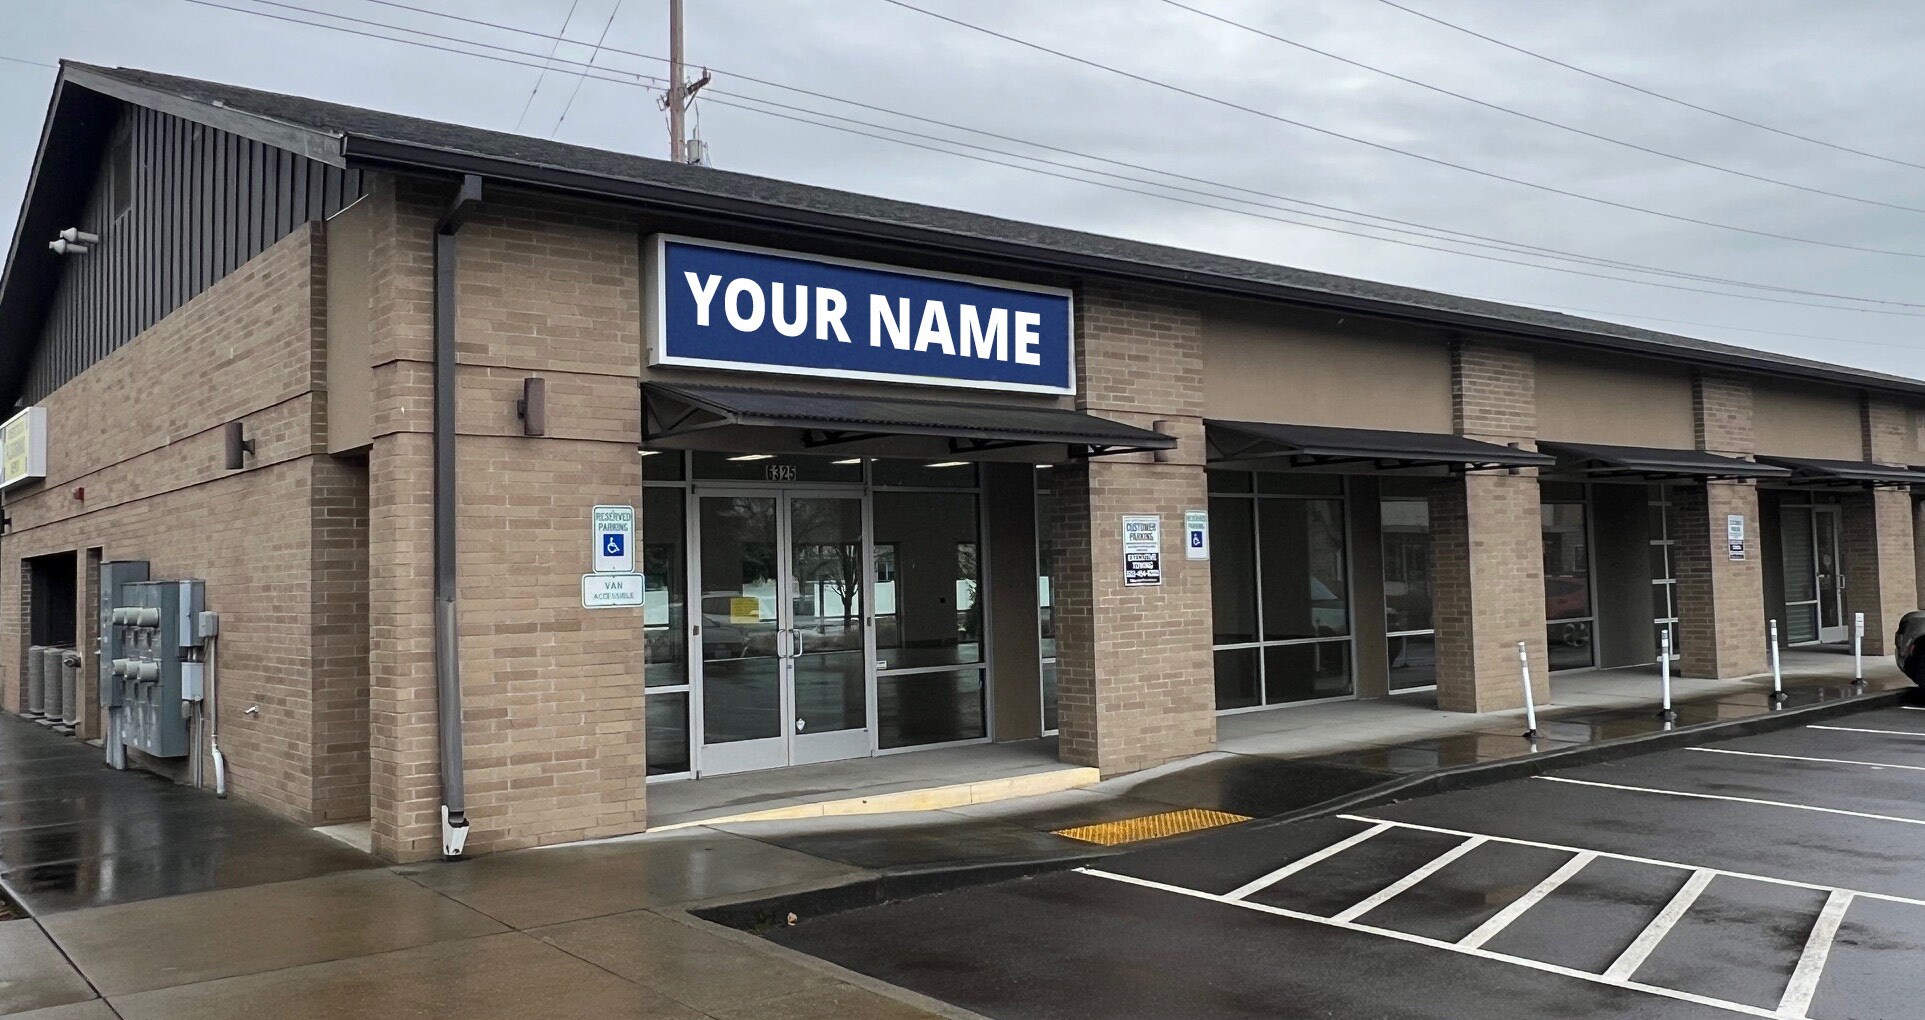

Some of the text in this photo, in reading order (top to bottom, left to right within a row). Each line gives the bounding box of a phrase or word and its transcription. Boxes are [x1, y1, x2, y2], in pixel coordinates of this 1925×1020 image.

[683, 270, 1041, 366] YOUR NAME
[766, 464, 797, 481] 6325
[595, 512, 631, 522] RESERVED
[598, 523, 629, 532] PARKING
[1126, 522, 1157, 532] CUSTOMER
[1129, 532, 1154, 541] PARKING
[604, 582, 623, 590] VAN
